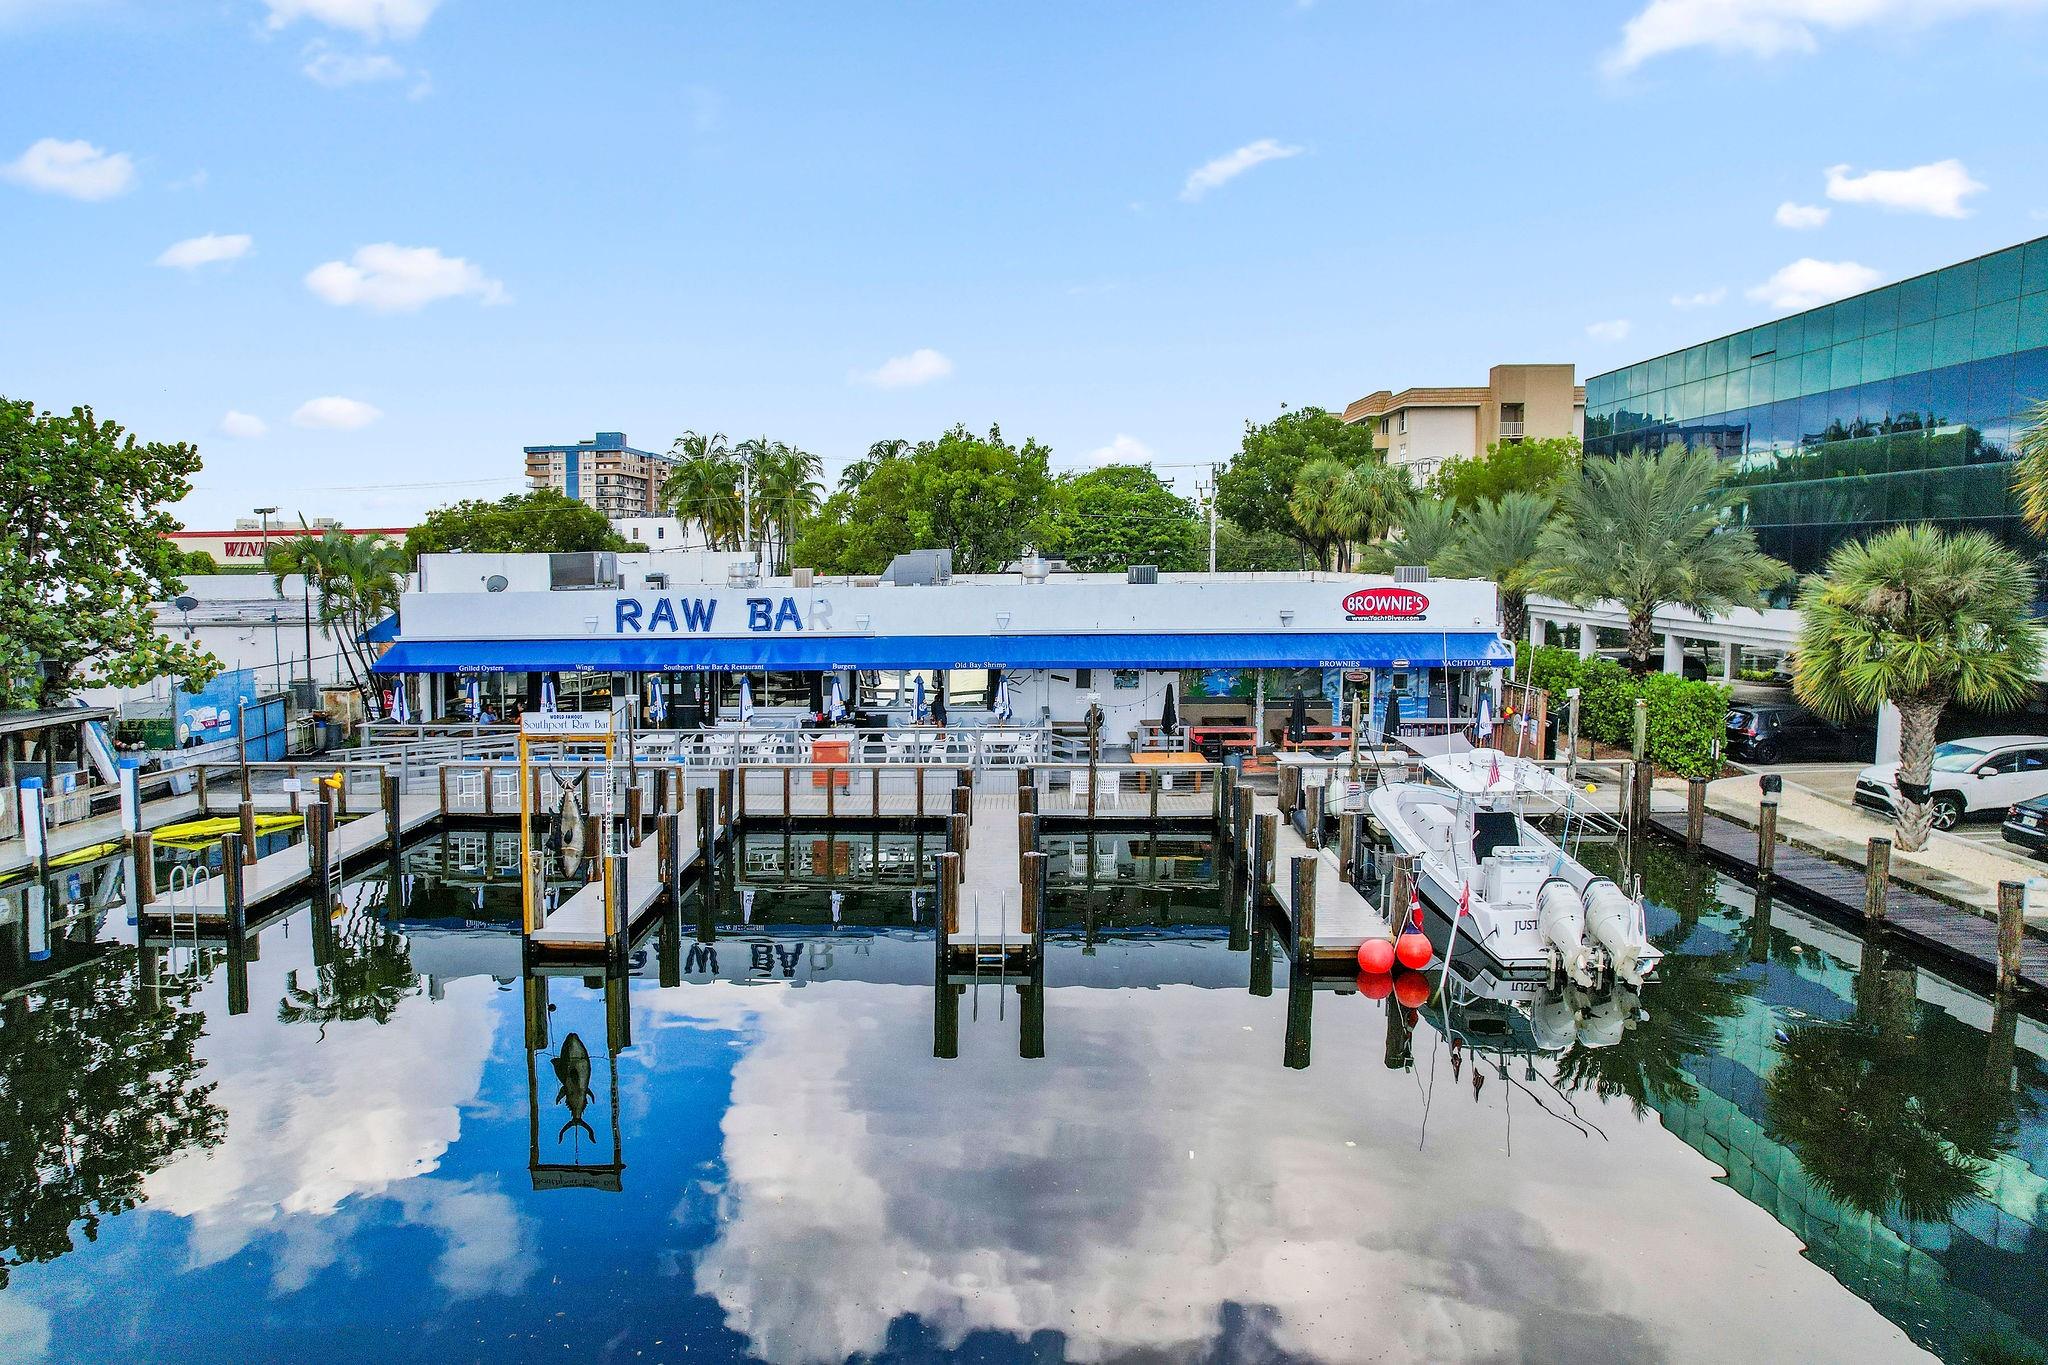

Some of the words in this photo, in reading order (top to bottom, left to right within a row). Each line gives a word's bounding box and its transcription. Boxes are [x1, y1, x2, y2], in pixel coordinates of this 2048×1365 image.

[1347, 595, 1424, 611] BROWNIE'S
[616, 597, 718, 633] RAW
[746, 596, 833, 632] BAR
[832, 662, 857, 671] Burgers
[954, 661, 967, 669] Old
[969, 662, 982, 670] Bay
[983, 661, 1007, 669] Shrimp
[1319, 660, 1361, 668] BROWNIES
[1442, 659, 1492, 667] YACHTDIVER
[481, 665, 504, 673] Oysters
[575, 664, 595, 672] Wings
[524, 719, 567, 732] Southport
[572, 720, 590, 729] Raw
[594, 720, 608, 729] Bar
